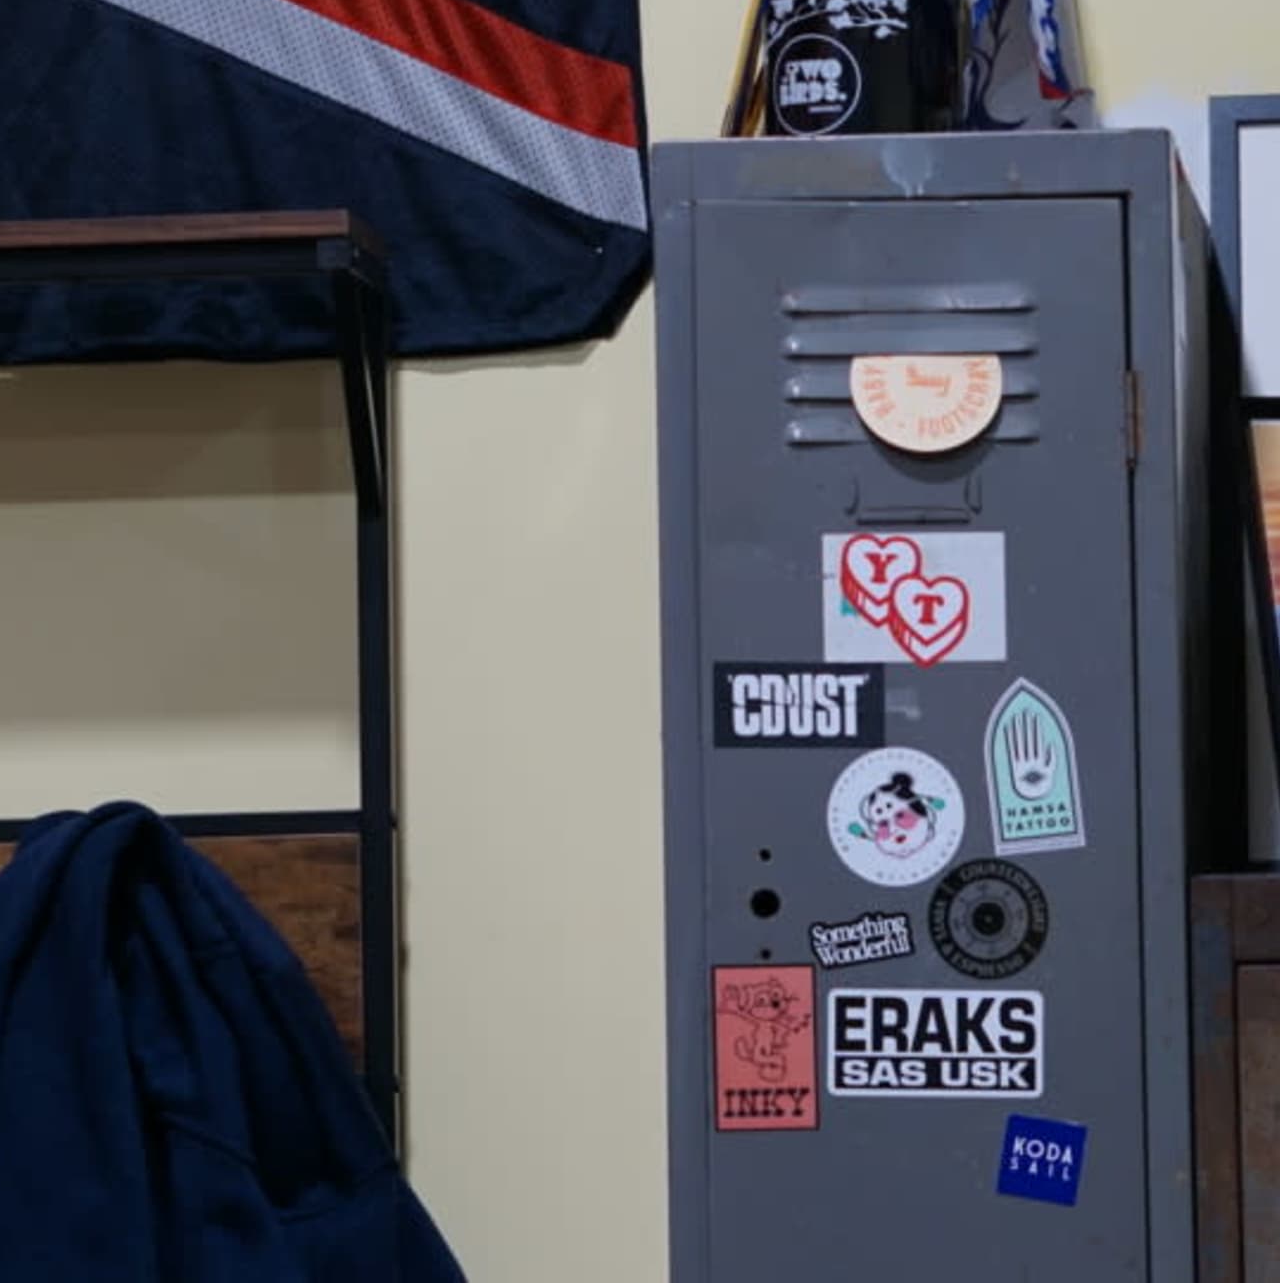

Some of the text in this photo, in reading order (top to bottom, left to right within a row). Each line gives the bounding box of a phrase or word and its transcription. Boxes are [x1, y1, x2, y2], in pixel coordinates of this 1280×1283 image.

[863, 552, 900, 584] Y
[913, 593, 945, 626] T
[1007, 801, 1066, 817] HAMSA
[1006, 817, 1070, 832] TATTOO
[813, 915, 908, 946] Something
[816, 929, 911, 966] Wonderful
[835, 996, 1036, 1054] ERAKS
[842, 1059, 1030, 1088] SAS USK
[724, 1088, 809, 1118] INKY
[1013, 1135, 1074, 1165] KODA
[1009, 1156, 1070, 1182] SAIL
